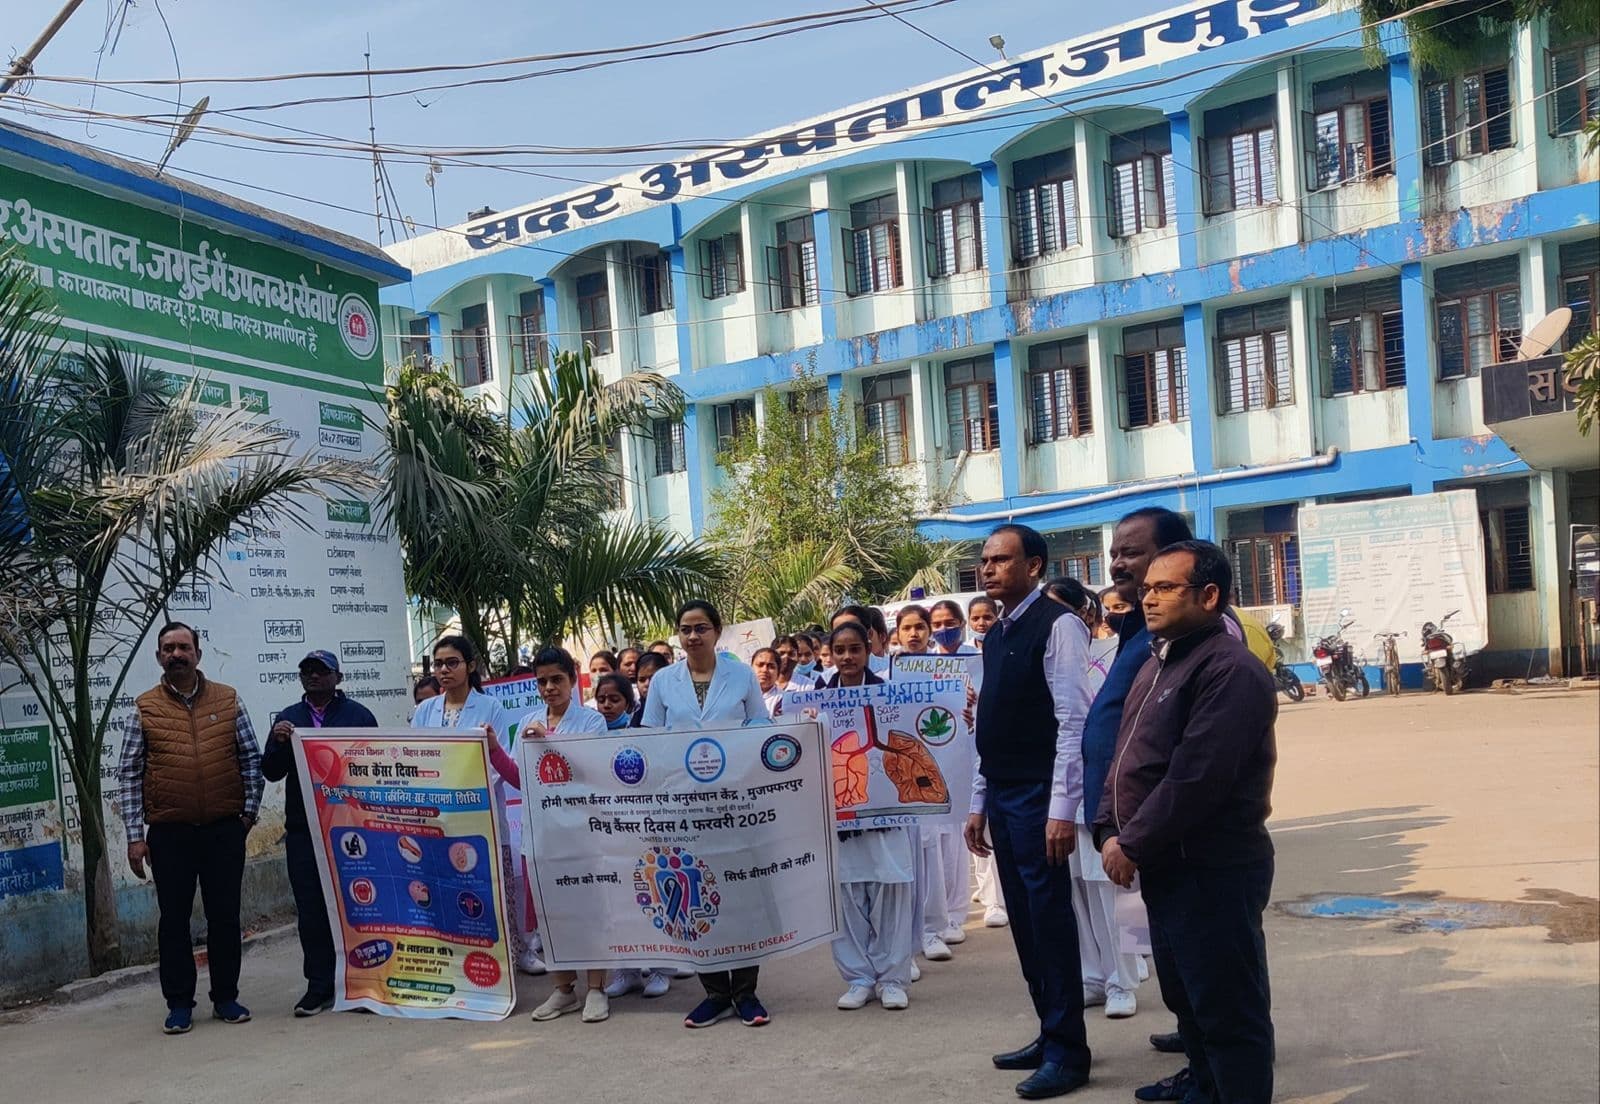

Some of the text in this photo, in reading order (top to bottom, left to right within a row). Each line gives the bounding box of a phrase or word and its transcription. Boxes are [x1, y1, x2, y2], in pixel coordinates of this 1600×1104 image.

[464, 183, 622, 250] सदर
[640, 52, 1060, 202] अस्पताल,
[58, 269, 131, 305] कायाकल्प
[233, 313, 261, 338] लक्ष्य
[264, 319, 306, 350] प्रमाणित
[306, 326, 319, 360] है
[792, 692, 824, 704] GNM
[838, 687, 870, 700] PMI
[877, 680, 961, 697] INSTITUTE
[22, 703, 39, 716] 102
[403, 747, 419, 758] बिहार
[29, 760, 47, 773] 1720
[372, 761, 392, 777] कैंसर
[396, 762, 418, 778] दिवस
[541, 794, 562, 810] होमी
[564, 795, 587, 807] भाभा
[588, 793, 611, 806] कैंसर
[614, 794, 653, 806] अस्पताल
[655, 792, 669, 806] एवं
[672, 789, 718, 806] अनुसंधान
[747, 778, 803, 801] मुजफ्फरपुर
[589, 809, 777, 835] विश्व कैंसर दिवस 4 फरवरी 2025
[556, 875, 579, 886] मरीज
[582, 873, 593, 884] को
[724, 868, 747, 883] सिर्फ
[749, 862, 778, 878] बीमारी
[780, 858, 792, 870] को
[641, 944, 657, 953] THE
[693, 948, 710, 958] NOT
[712, 946, 736, 957] JUST
[739, 942, 758, 952] THE
